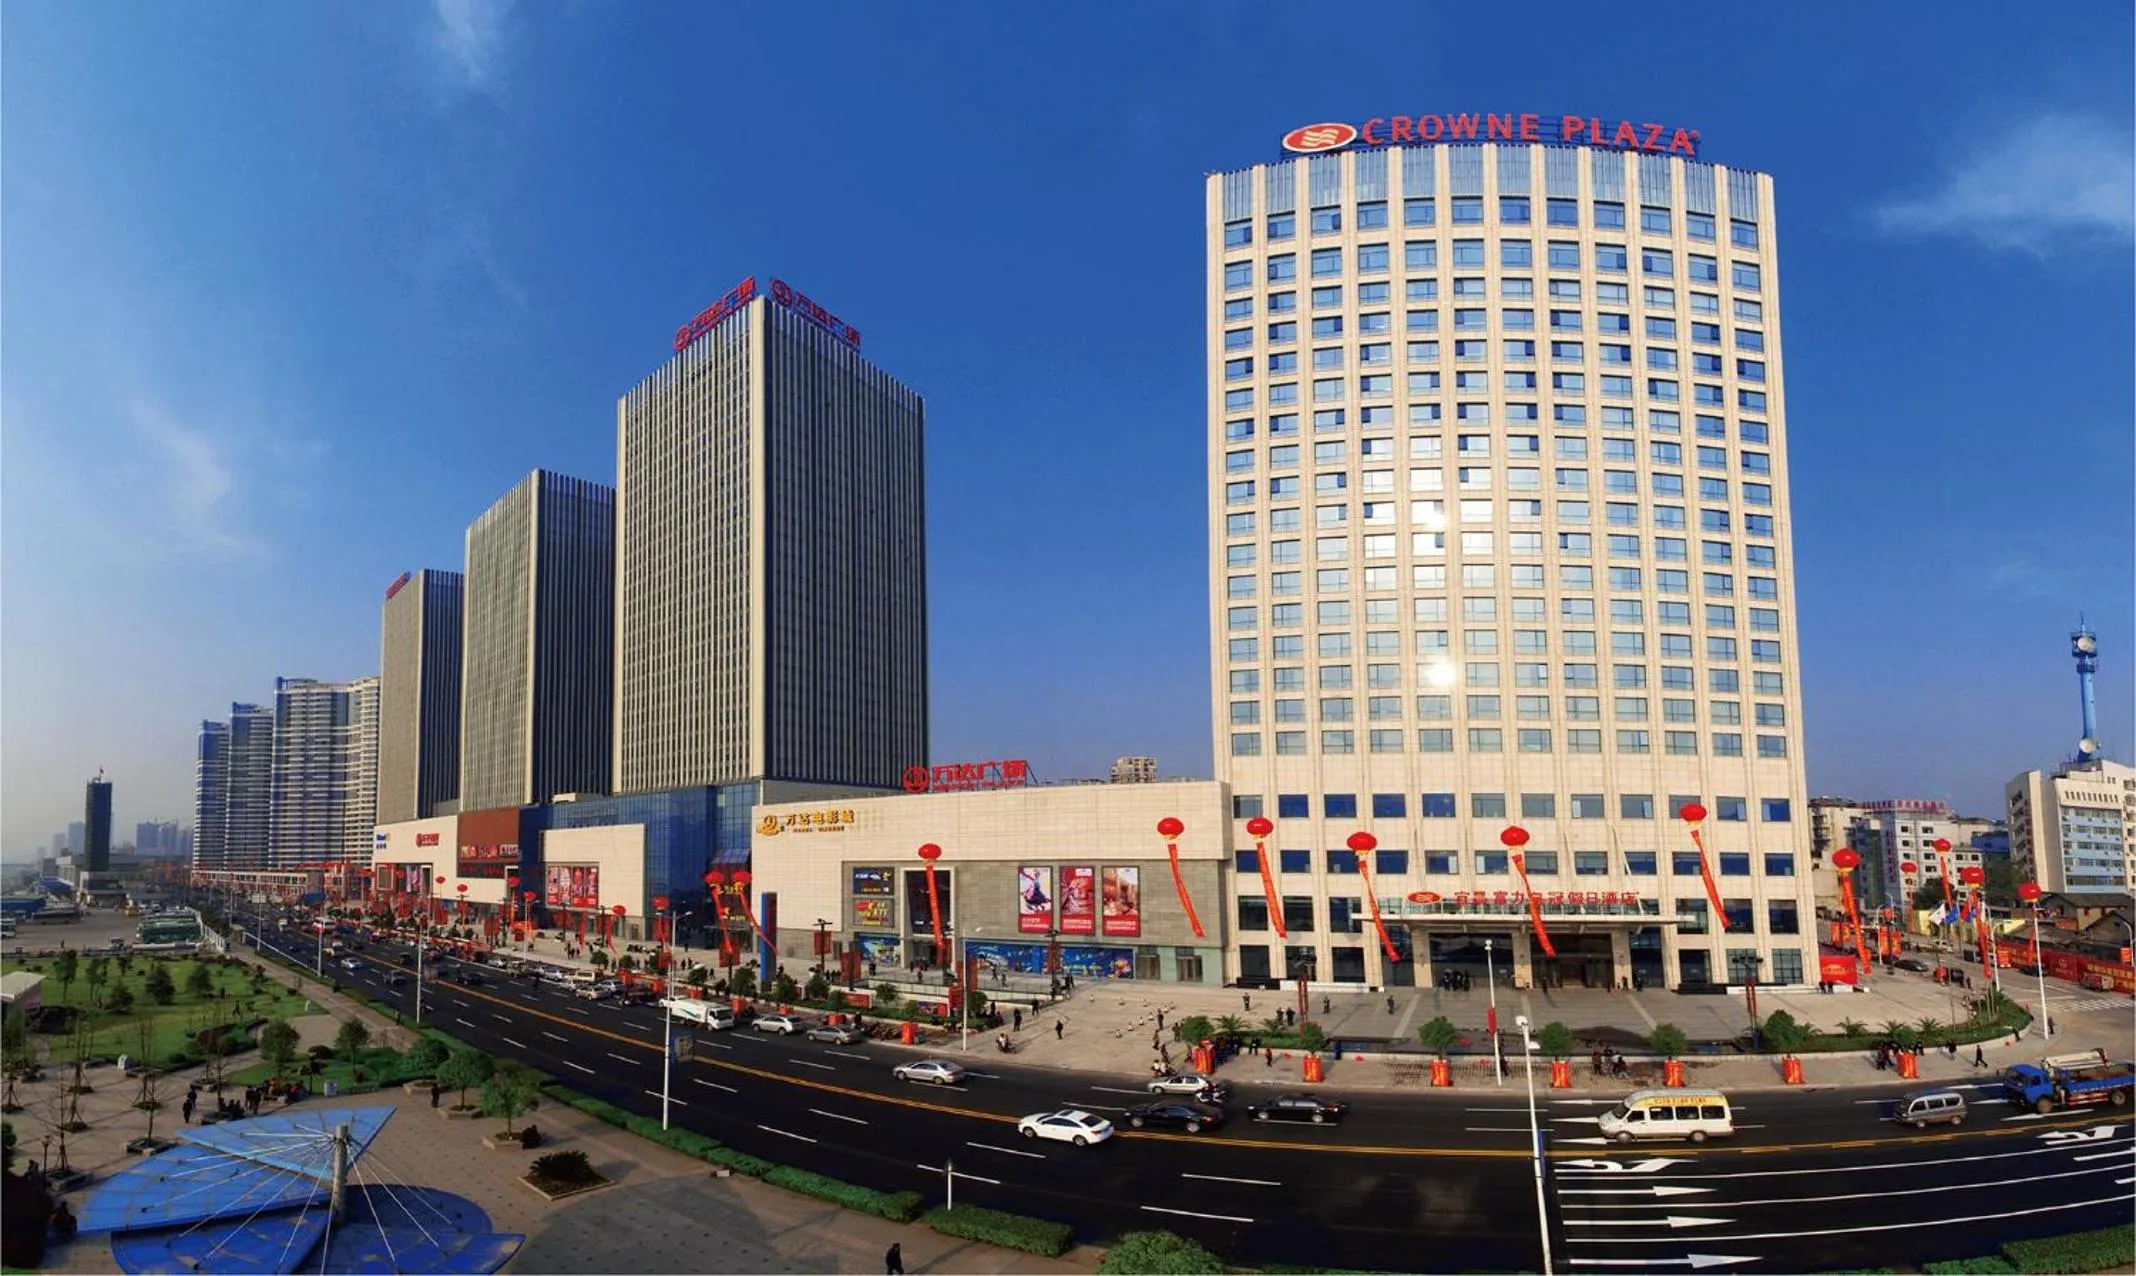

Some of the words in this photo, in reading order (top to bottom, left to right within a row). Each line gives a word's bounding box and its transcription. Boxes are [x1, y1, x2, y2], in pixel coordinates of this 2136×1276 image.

[1362, 113, 1540, 145] CROWNE
[1563, 114, 1696, 156] PLAZA
[932, 760, 1027, 784] 万达广场
